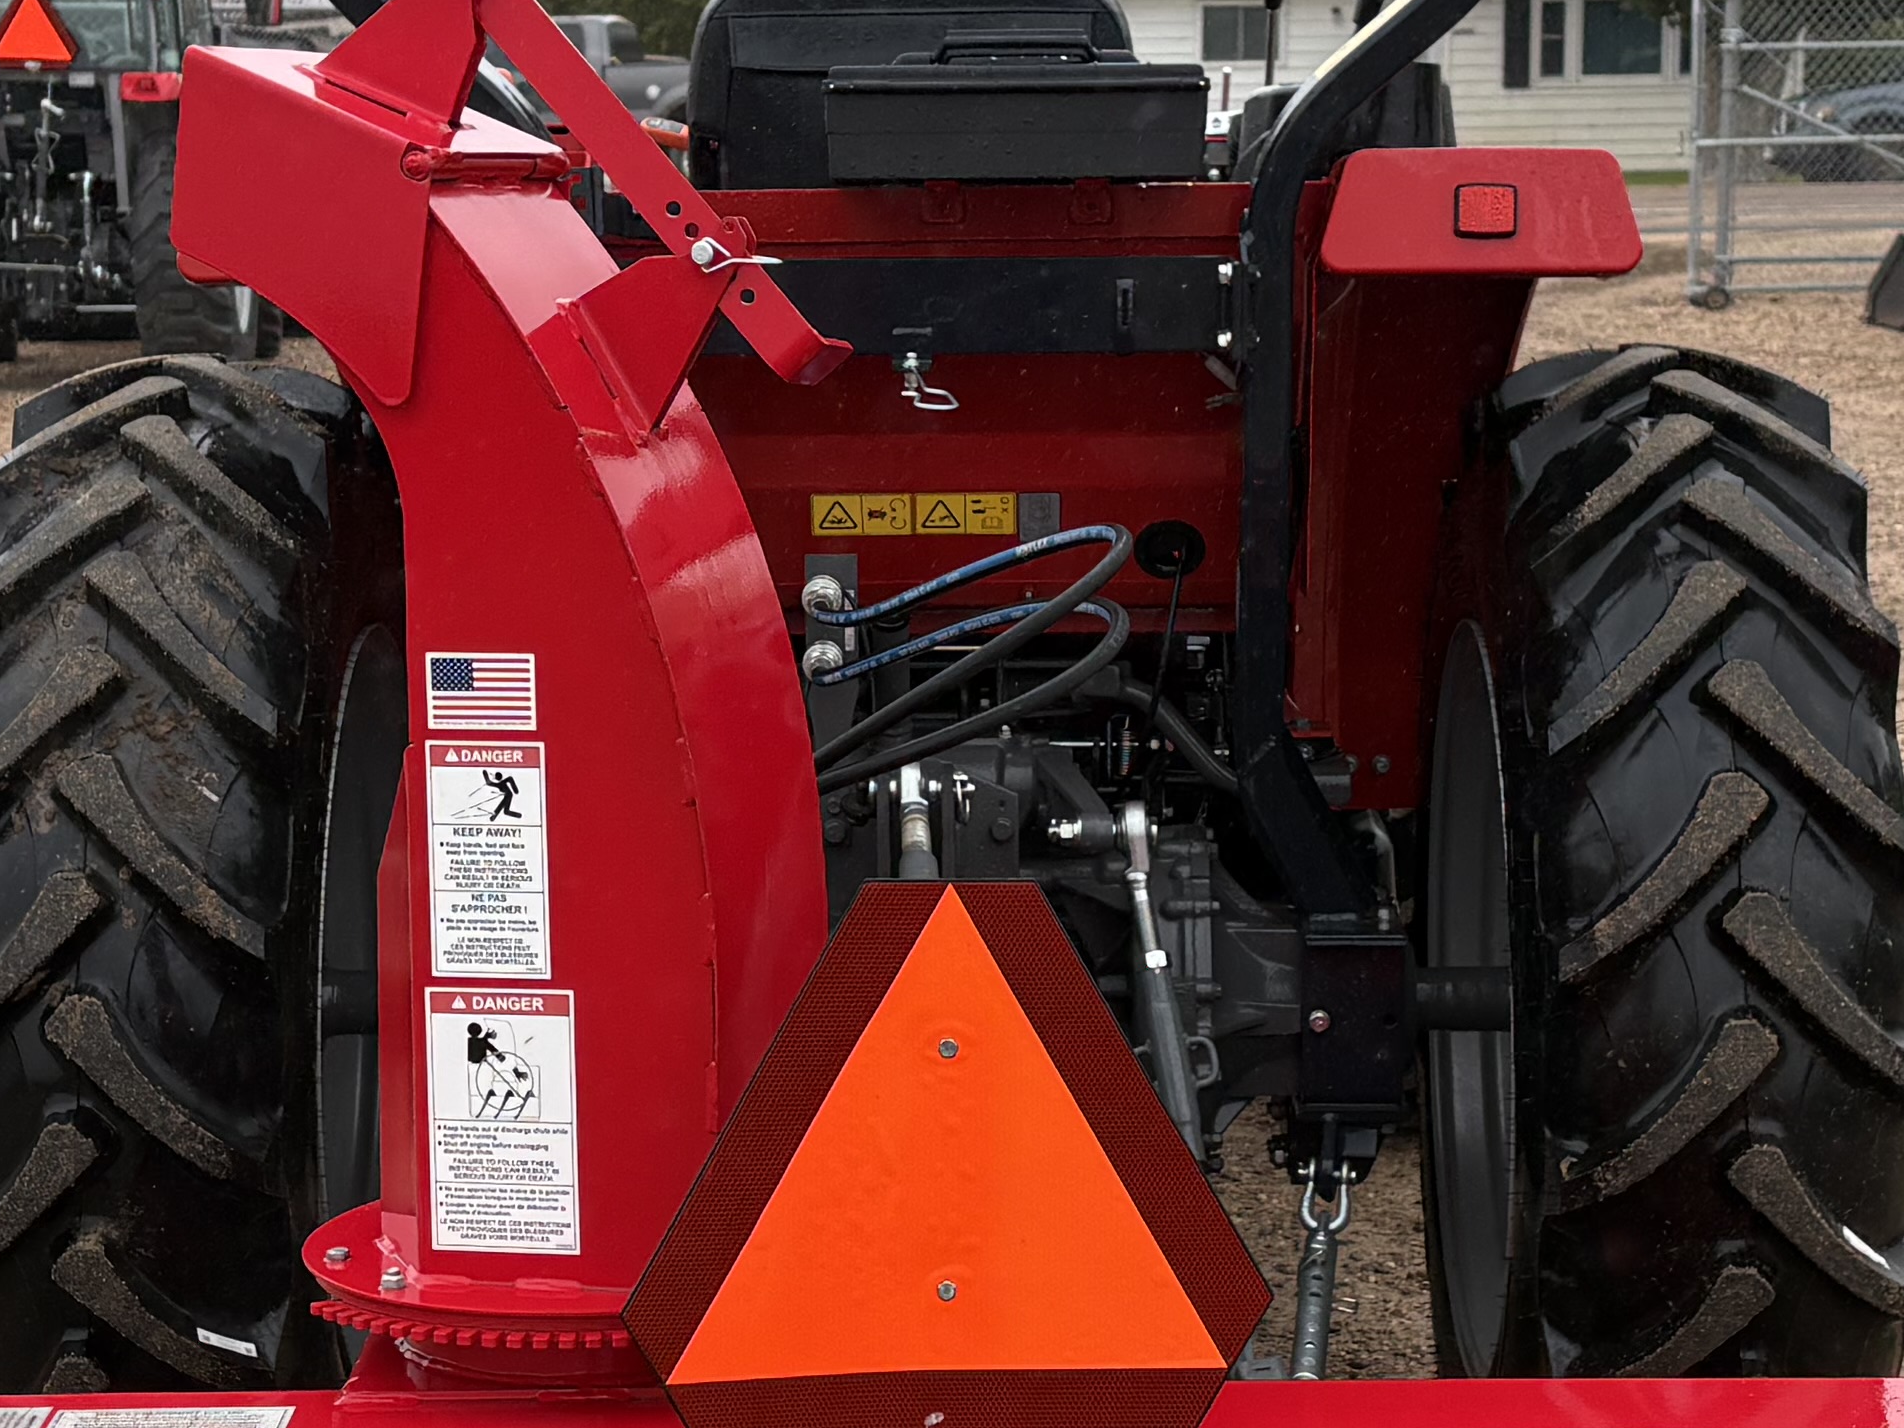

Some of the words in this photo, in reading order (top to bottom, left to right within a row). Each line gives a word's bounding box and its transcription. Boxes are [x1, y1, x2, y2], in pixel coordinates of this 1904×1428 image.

[461, 750, 523, 763] DANGER
[453, 827, 483, 838] KEEP
[486, 827, 521, 838] AWAY!
[472, 894, 485, 902] NE
[488, 894, 506, 902] PAS
[452, 905, 521, 914] S'APPROCHER
[472, 996, 544, 1011] DANGER
